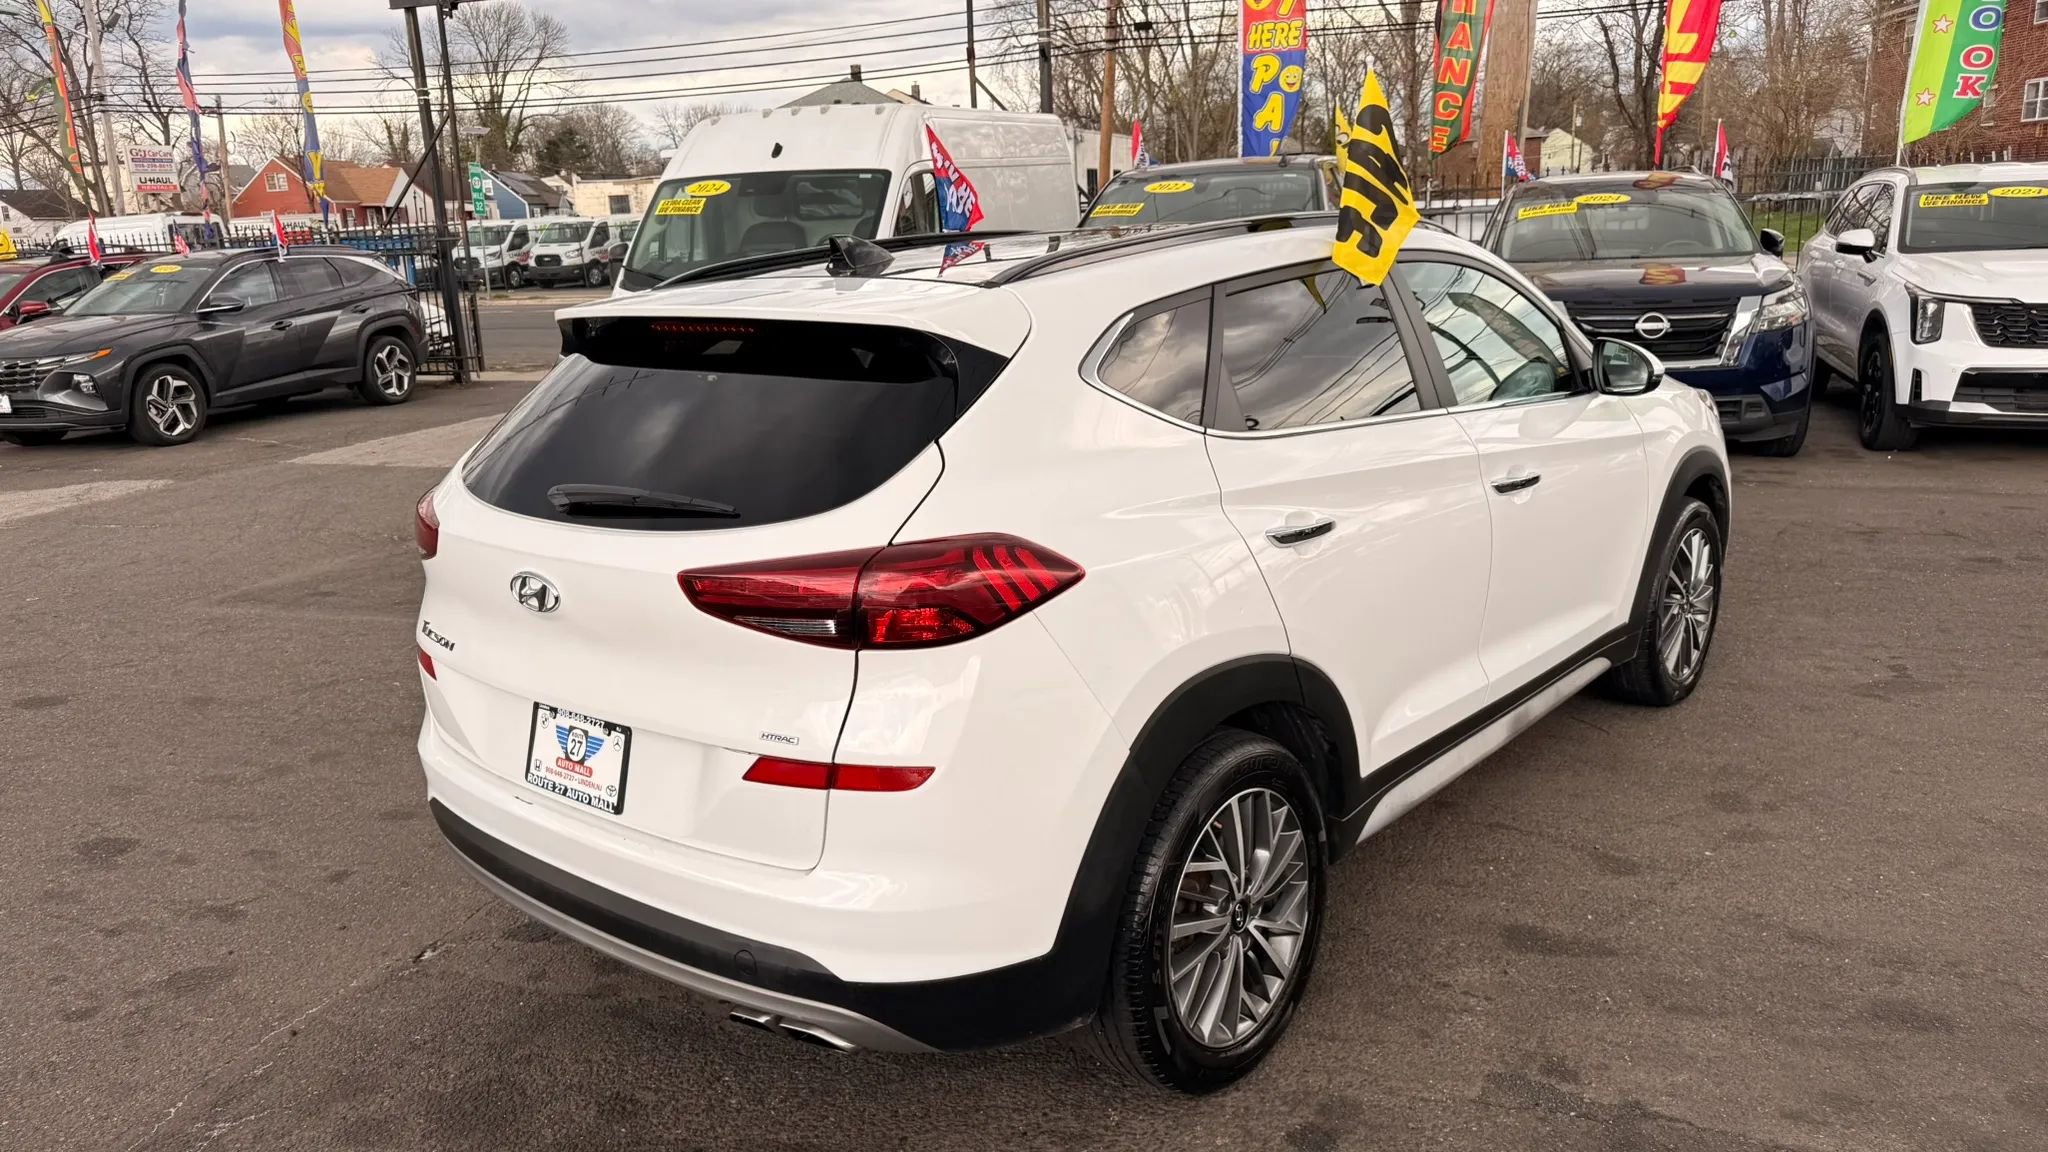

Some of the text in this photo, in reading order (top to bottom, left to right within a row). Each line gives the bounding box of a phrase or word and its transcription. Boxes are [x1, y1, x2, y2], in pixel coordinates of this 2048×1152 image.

[1248, 20, 1304, 50] HERE
[475, 201, 484, 211] 32
[571, 731, 584, 740] ROUTE
[761, 732, 796, 744] HTRAC
[569, 738, 583, 758] 27
[557, 759, 591, 776] AUTO MALL
[527, 773, 616, 813] ROUTE 27 AUTO MALL
